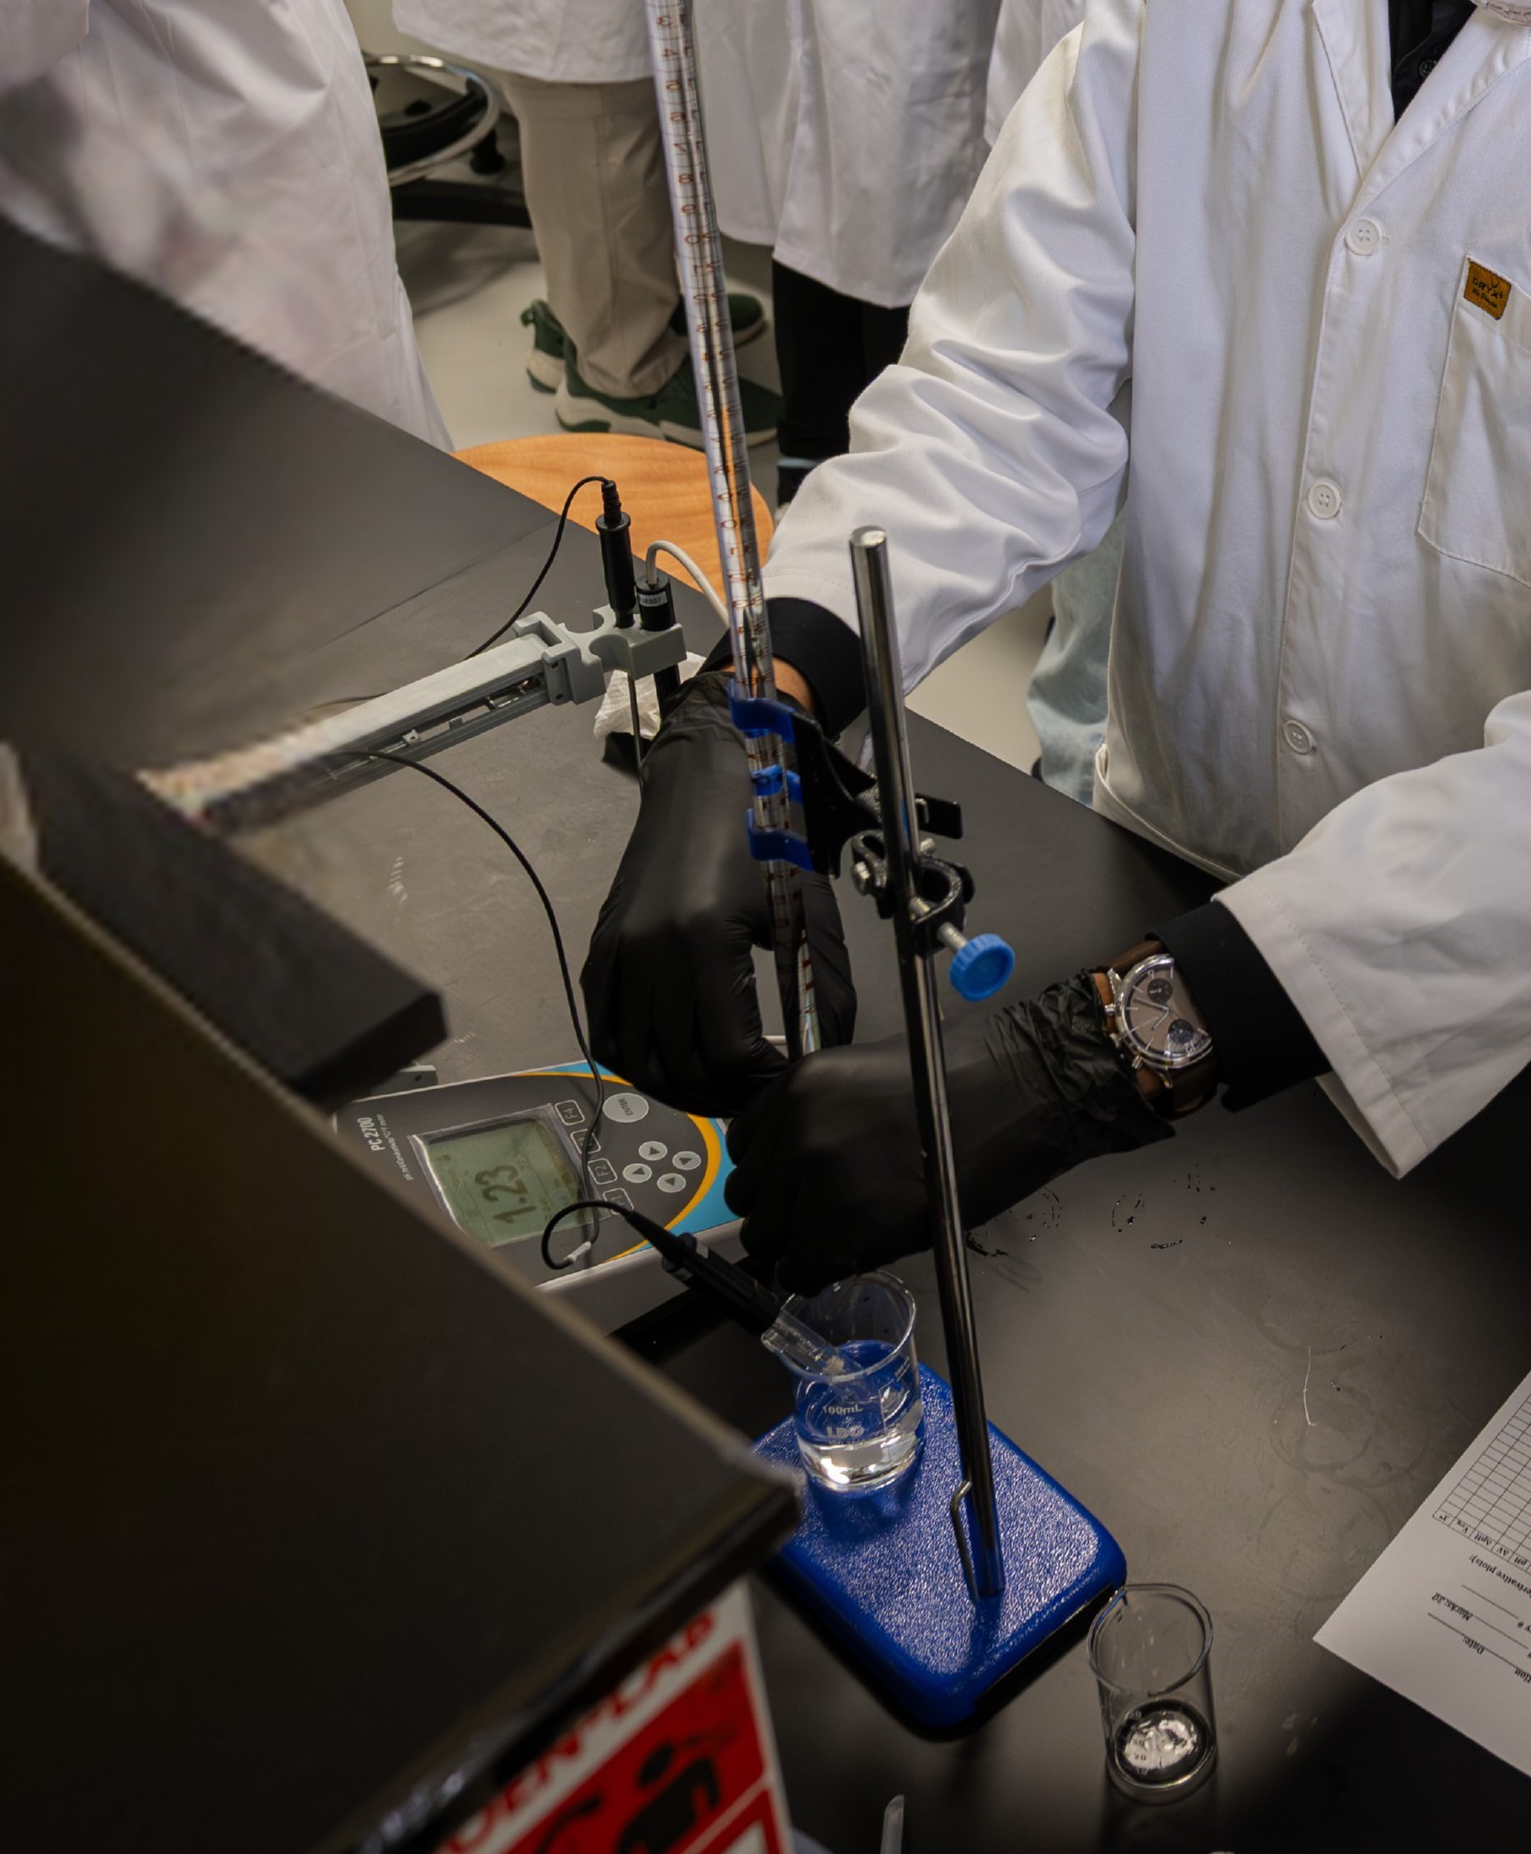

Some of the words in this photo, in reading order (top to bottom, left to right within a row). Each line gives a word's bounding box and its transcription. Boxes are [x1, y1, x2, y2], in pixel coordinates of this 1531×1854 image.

[562, 1107, 578, 1120] F4
[620, 1096, 634, 1117] ENTER
[356, 1117, 380, 1139] 2700
[368, 1138, 386, 1152] PC
[594, 1164, 611, 1178] F2
[474, 1163, 537, 1224] 1.23
[1468, 1554, 1498, 1575] plots):
[1431, 1592, 1447, 1605] 30
[1444, 1598, 1474, 1622] Marks:
[1462, 1634, 1487, 1655] Date:
